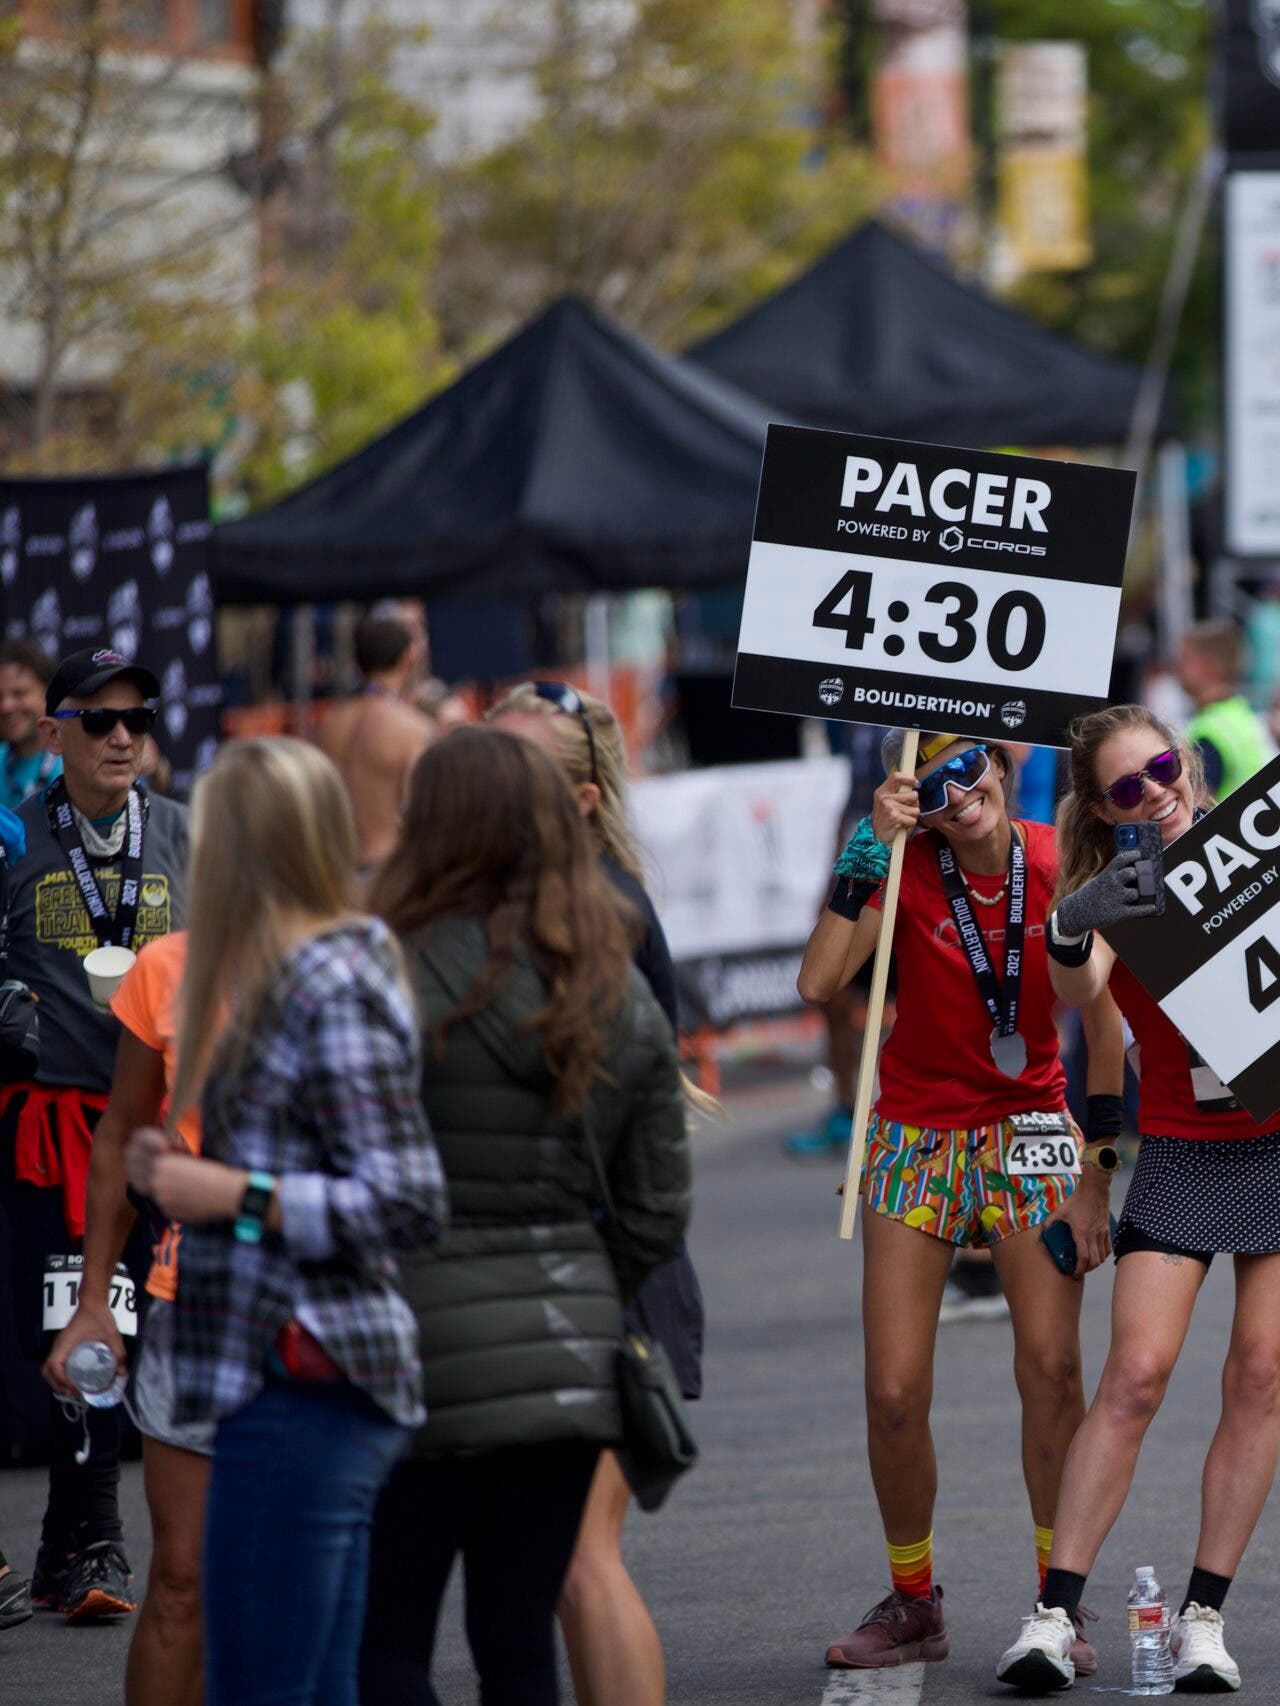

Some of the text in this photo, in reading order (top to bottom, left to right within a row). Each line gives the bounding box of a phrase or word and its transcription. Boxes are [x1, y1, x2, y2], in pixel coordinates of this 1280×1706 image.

[840, 455, 1052, 533] PACER
[837, 519, 1047, 556] POWERED BY COROS
[812, 569, 1046, 672] 4:30
[853, 687, 991, 718] BOULDERTHON
[56, 803, 72, 829] 2021
[128, 789, 142, 859] BOULDERTHON
[939, 847, 956, 875] 2021
[69, 846, 107, 918] BOULDERTHON
[121, 879, 138, 906] 2021
[1009, 845, 1025, 923] BOULDERTHON
[1202, 878, 1262, 934] POWERED
[1262, 865, 1279, 884] BY
[952, 897, 990, 974] BOULDERTHON
[1006, 949, 1021, 977] 2021
[1008, 1111, 1062, 1126] PACER
[1010, 1142, 1075, 1168] 4:30
[43, 1280, 136, 1313] 1178
